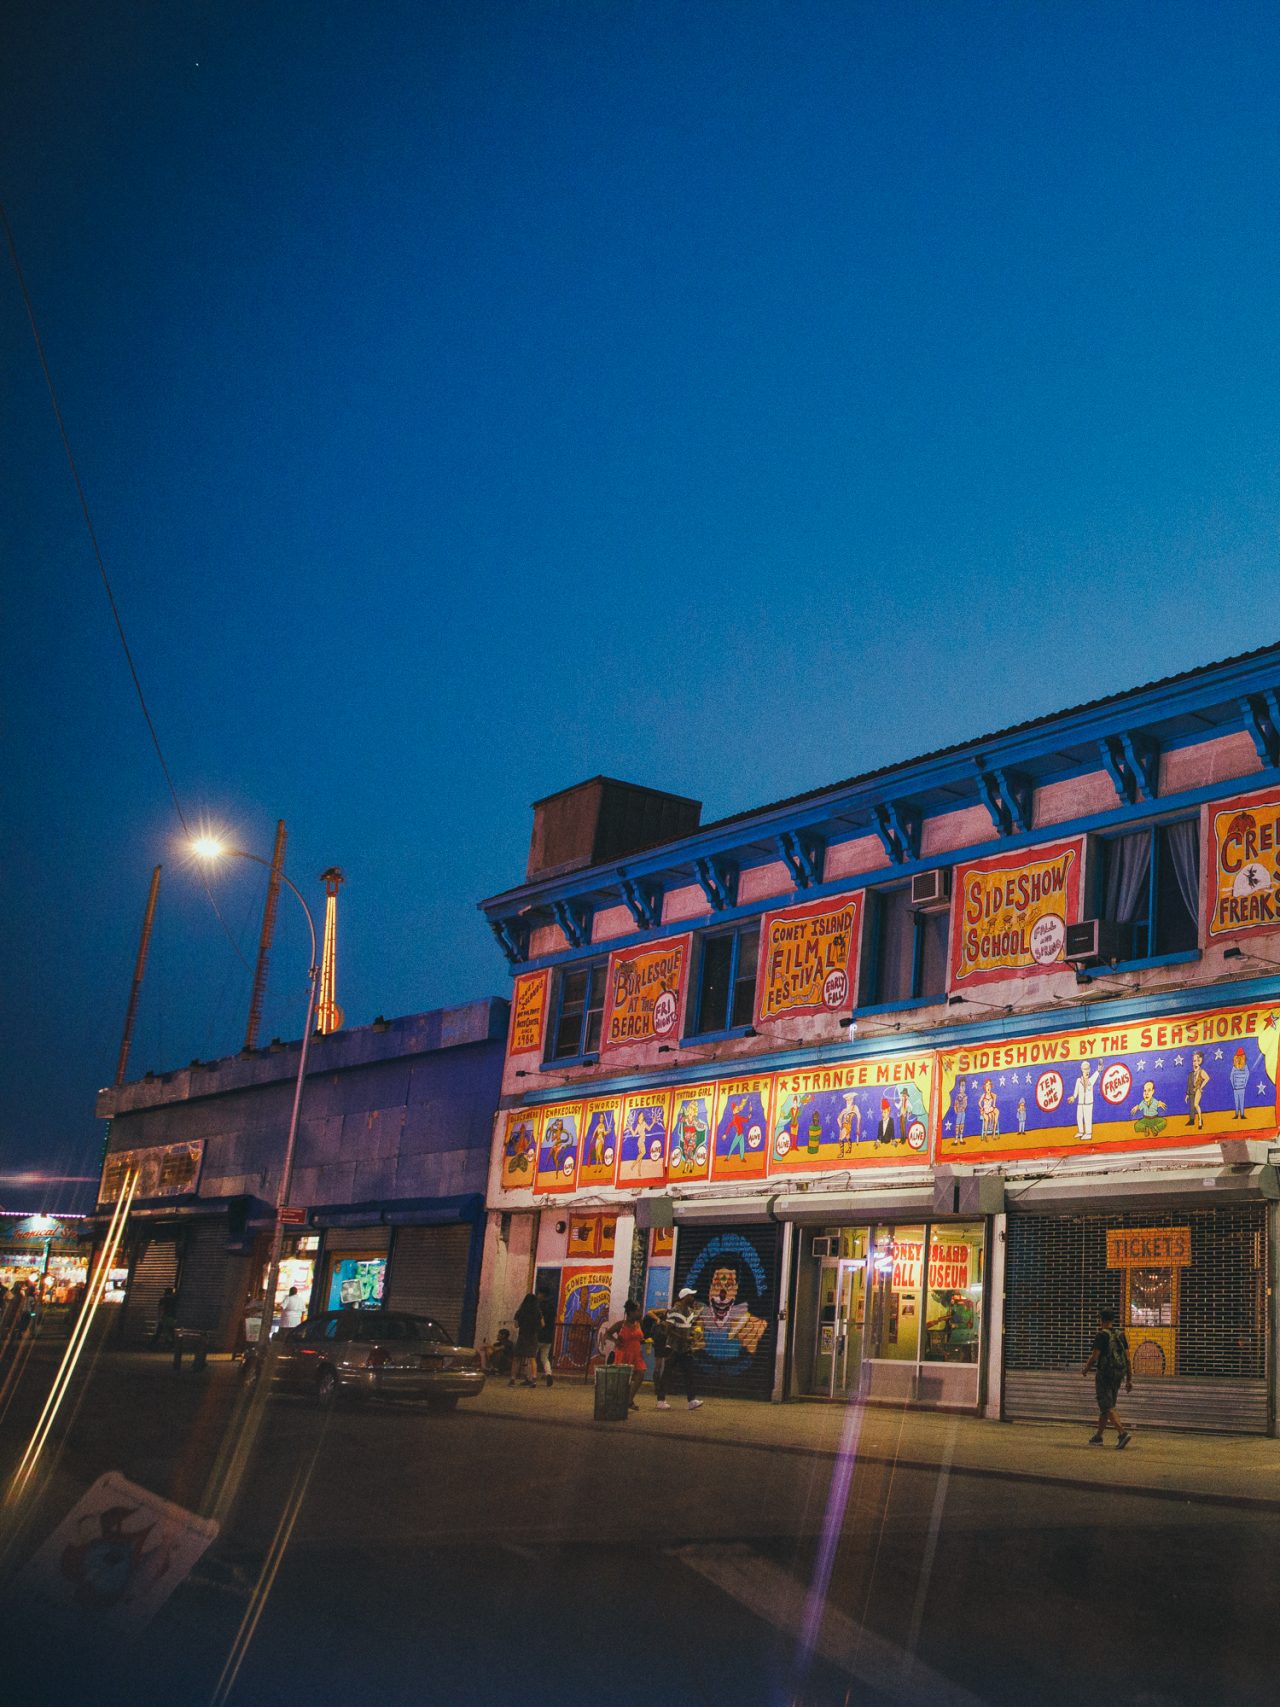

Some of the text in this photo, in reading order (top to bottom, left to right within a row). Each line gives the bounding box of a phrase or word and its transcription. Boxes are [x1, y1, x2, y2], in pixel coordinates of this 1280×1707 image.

[967, 856, 1069, 924] SIDESHOW
[1220, 892, 1275, 924] FREAK
[772, 912, 852, 943] CONEY ISLAND
[1033, 920, 1057, 940] FALL
[967, 928, 1030, 962] SCHOOL
[771, 937, 819, 988] FILM
[614, 951, 681, 1008] BURLESQUE
[767, 943, 836, 1011] FESTIVAL
[826, 975, 846, 994] EARLY
[628, 996, 655, 1013] AT THE
[656, 999, 671, 1020] FRI
[612, 1014, 649, 1038] BEACH
[958, 1013, 1258, 1072] SIDESHOWS BY THE SEASHORE
[728, 1081, 760, 1095] FIRE
[791, 1062, 916, 1093] STRANGE MEN
[1039, 1077, 1057, 1091] TEN
[1105, 1075, 1130, 1092] FREAKS
[589, 1101, 619, 1112] SWORDS
[628, 1094, 666, 1108] ELECTRA
[1043, 1093, 1059, 1107] ONE
[909, 1131, 924, 1142] ALIVE
[1113, 1236, 1186, 1259] TICKETS
[920, 1263, 967, 1288] USEUM
